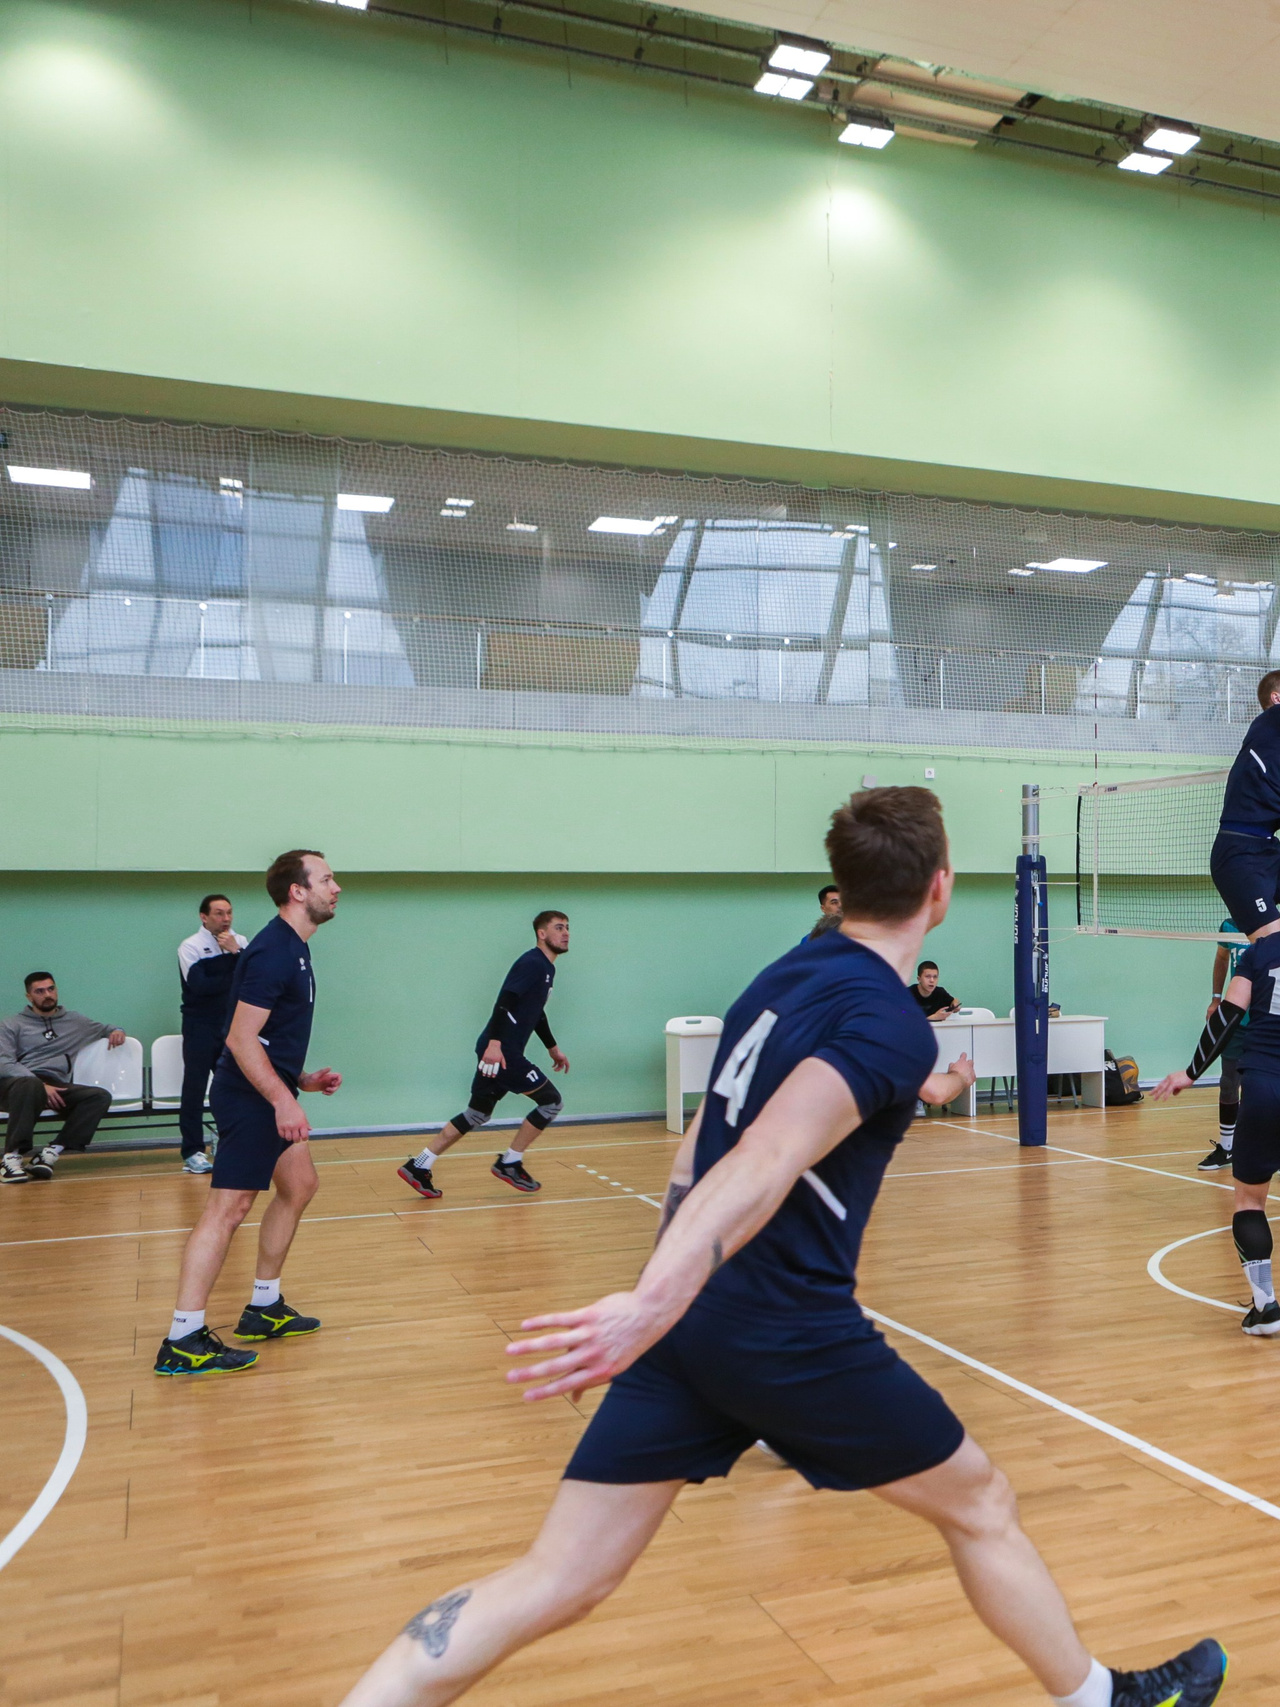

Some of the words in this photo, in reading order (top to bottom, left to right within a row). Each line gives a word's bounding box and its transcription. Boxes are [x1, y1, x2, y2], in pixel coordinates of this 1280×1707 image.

[1255, 898, 1267, 912] 5
[712, 1009, 778, 1127] 4
[526, 1069, 539, 1082] 17
